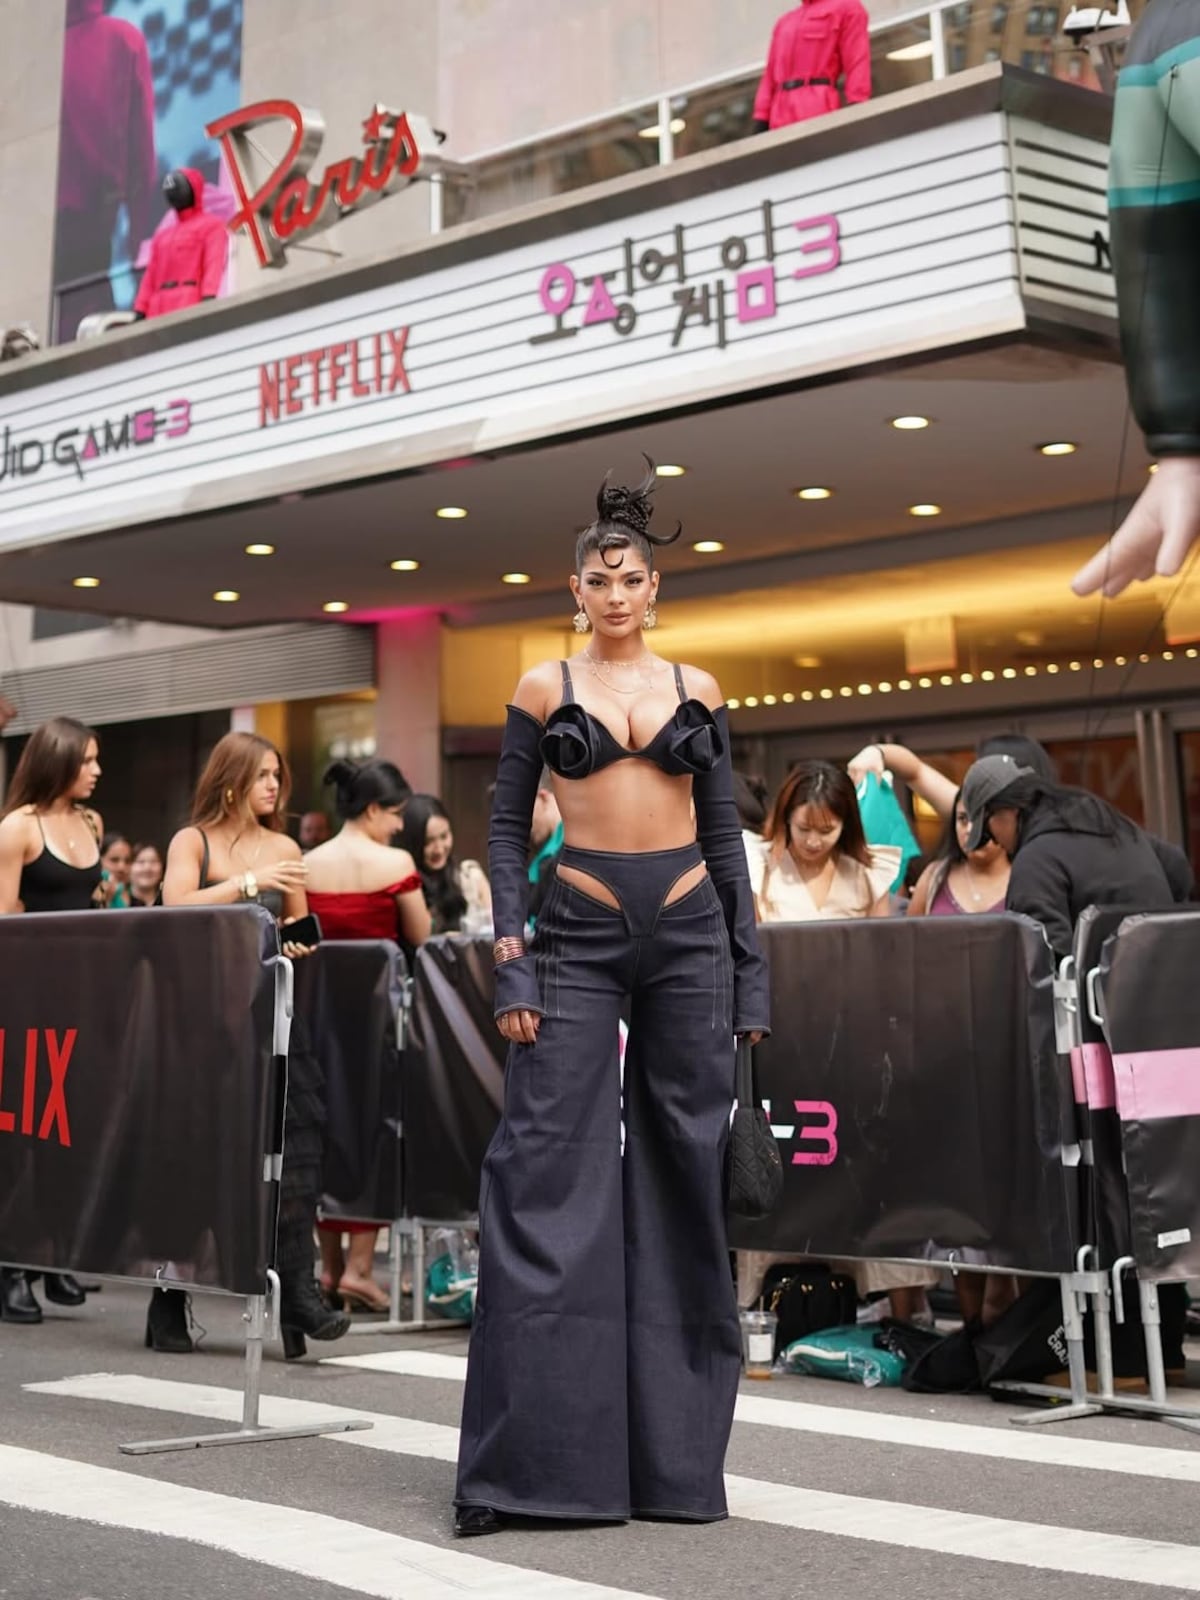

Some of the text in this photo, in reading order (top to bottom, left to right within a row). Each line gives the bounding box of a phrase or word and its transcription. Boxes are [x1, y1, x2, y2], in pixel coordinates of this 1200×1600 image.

[204, 99, 424, 269] Paris
[793, 212, 842, 281] 3
[259, 324, 412, 428] NETFLIX
